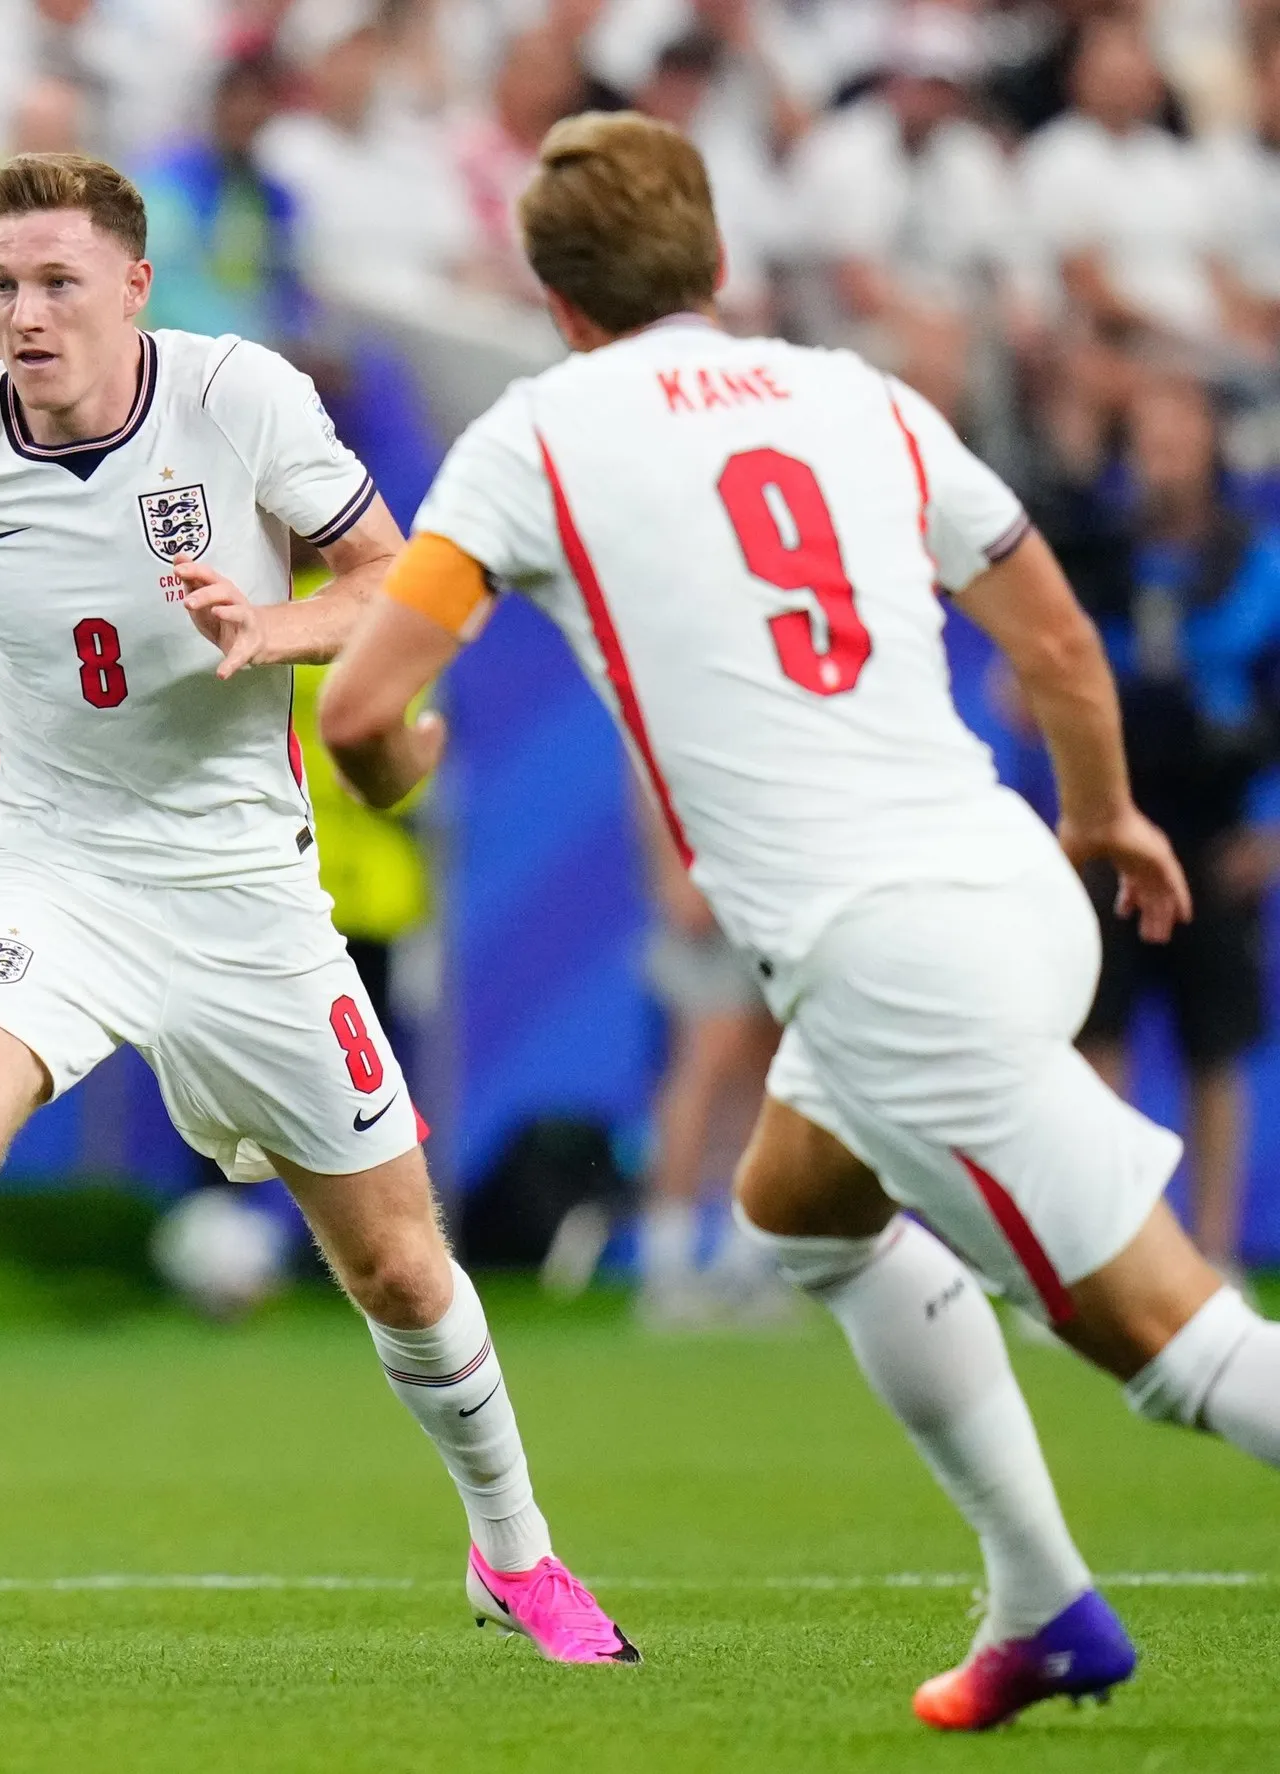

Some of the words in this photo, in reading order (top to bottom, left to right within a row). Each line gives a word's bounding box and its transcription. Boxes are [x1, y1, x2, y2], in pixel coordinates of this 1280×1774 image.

[657, 367, 791, 413] KANE
[159, 575, 182, 588] CRO
[165, 589, 184, 602] 17.0
[716, 446, 873, 698] 9
[73, 617, 128, 709] 8
[328, 994, 384, 1095] 8
